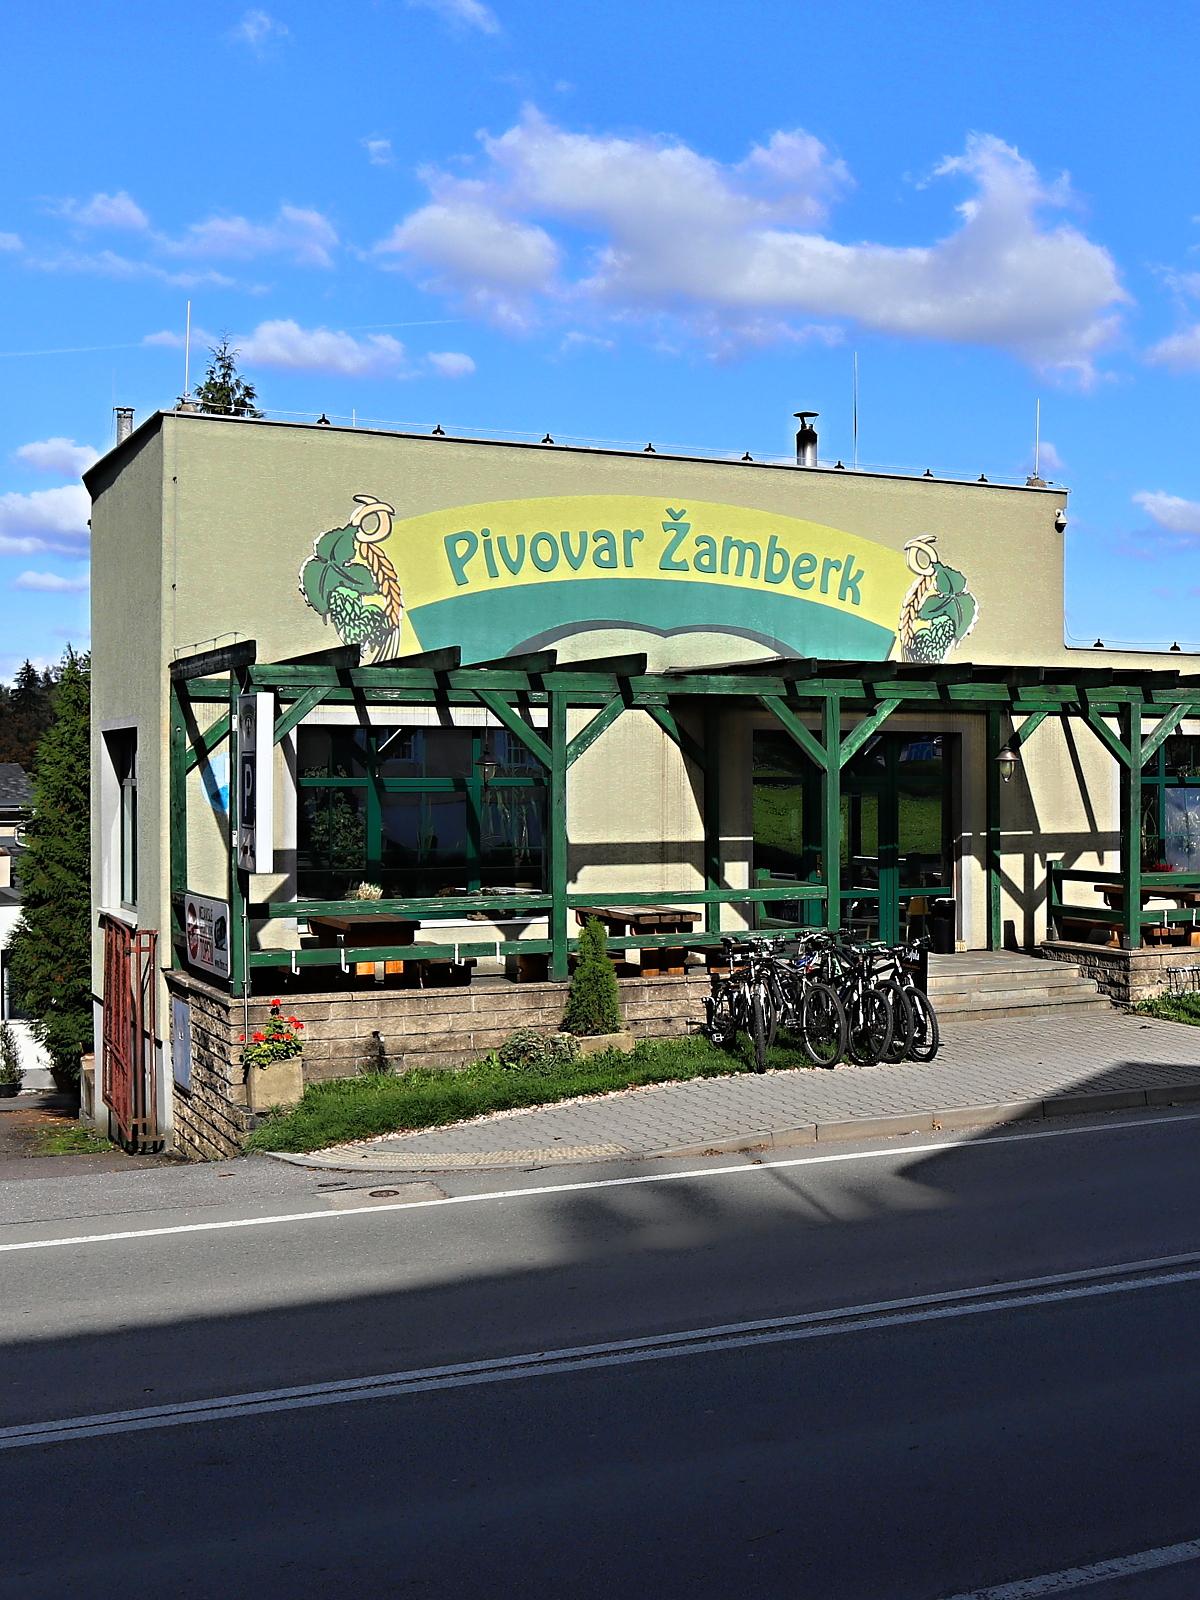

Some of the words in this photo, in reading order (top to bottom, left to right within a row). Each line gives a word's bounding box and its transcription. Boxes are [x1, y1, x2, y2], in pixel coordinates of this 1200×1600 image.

[443, 528, 644, 586] Pivovar
[658, 507, 866, 605] Žamberk
[243, 763, 253, 817] P
